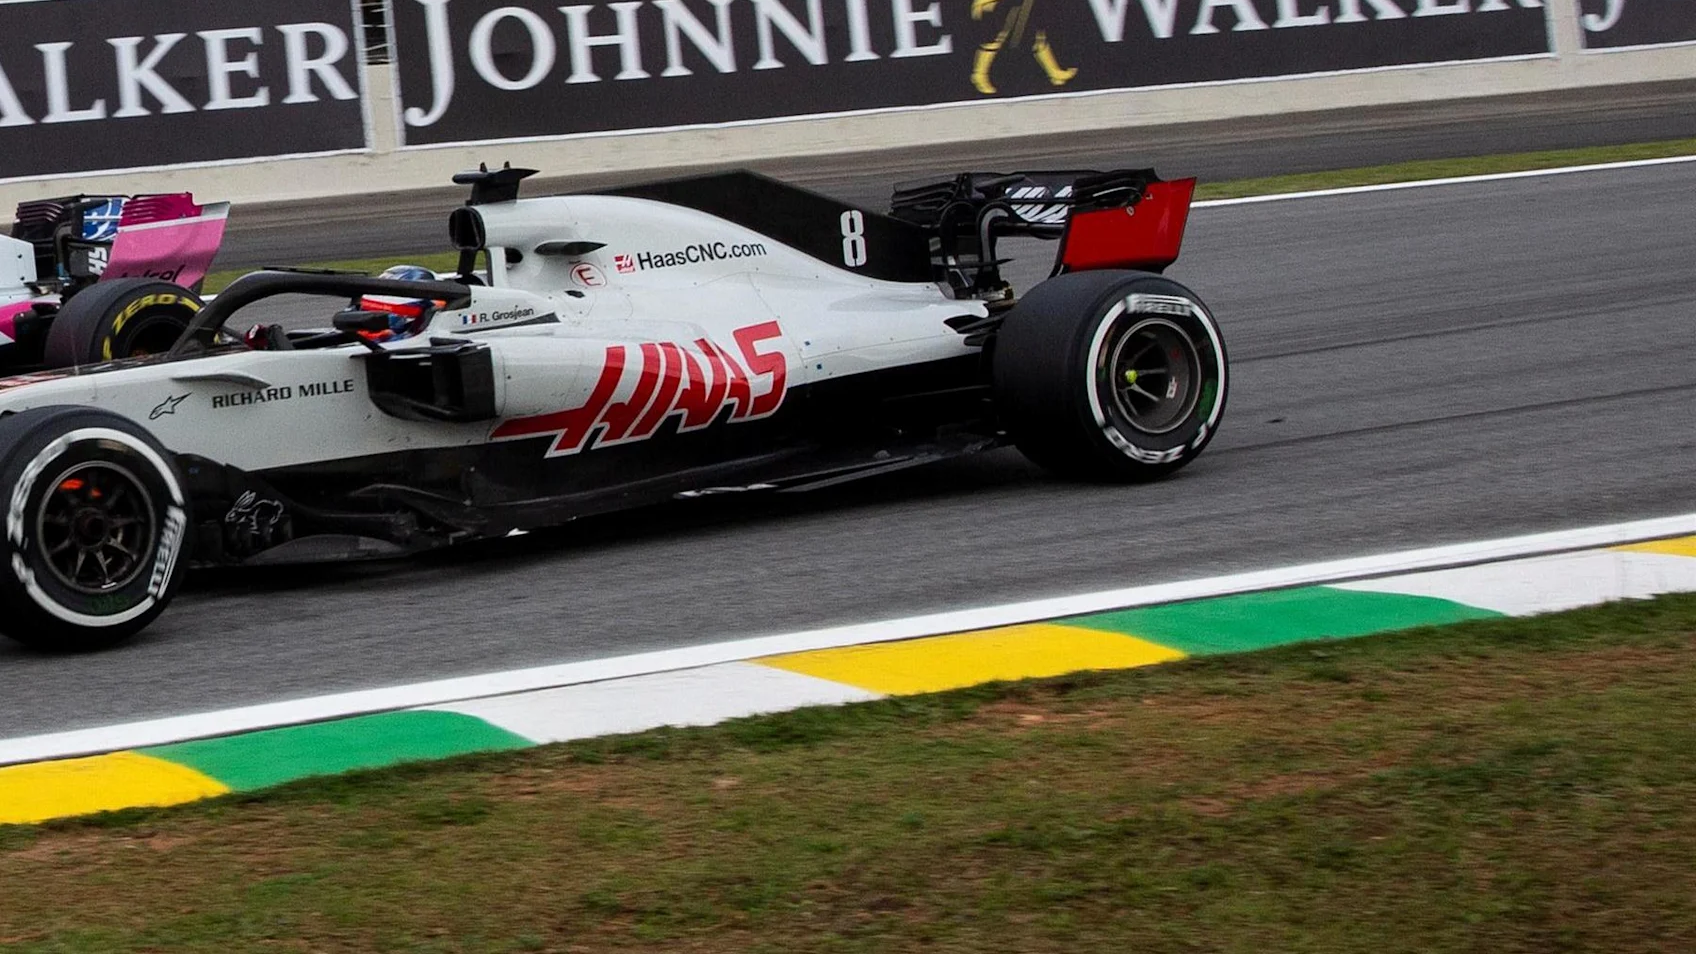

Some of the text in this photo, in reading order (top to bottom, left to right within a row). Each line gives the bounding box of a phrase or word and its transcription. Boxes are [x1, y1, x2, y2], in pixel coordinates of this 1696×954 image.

[840, 210, 867, 267] 8
[637, 242, 767, 271] HaasCNC.com
[576, 267, 601, 286] E
[479, 307, 534, 323] R. Grosjean
[212, 379, 354, 408] RICHARD MILLE
[488, 321, 790, 457] HAAS
